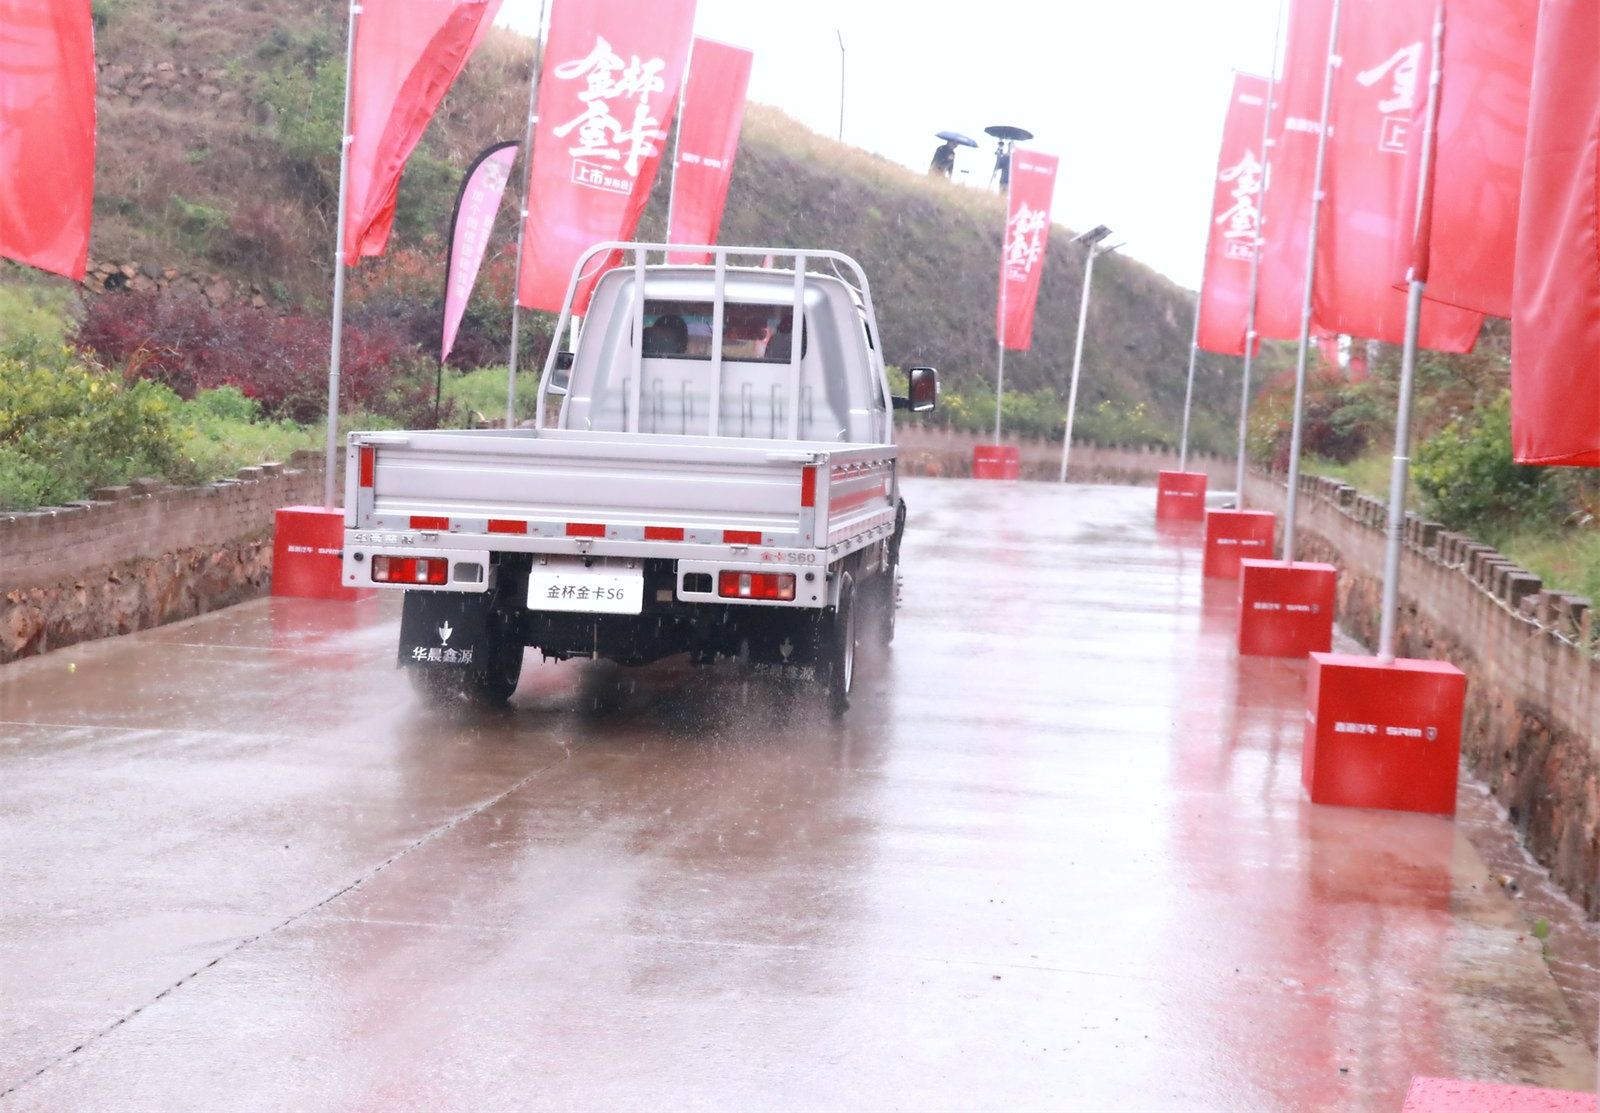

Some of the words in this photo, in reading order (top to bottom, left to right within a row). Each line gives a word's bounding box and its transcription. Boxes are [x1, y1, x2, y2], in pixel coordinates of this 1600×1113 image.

[553, 35, 665, 104] 金杯
[547, 584, 624, 600] 金杯金卡S6
[412, 646, 473, 664] 华晨鑫源
